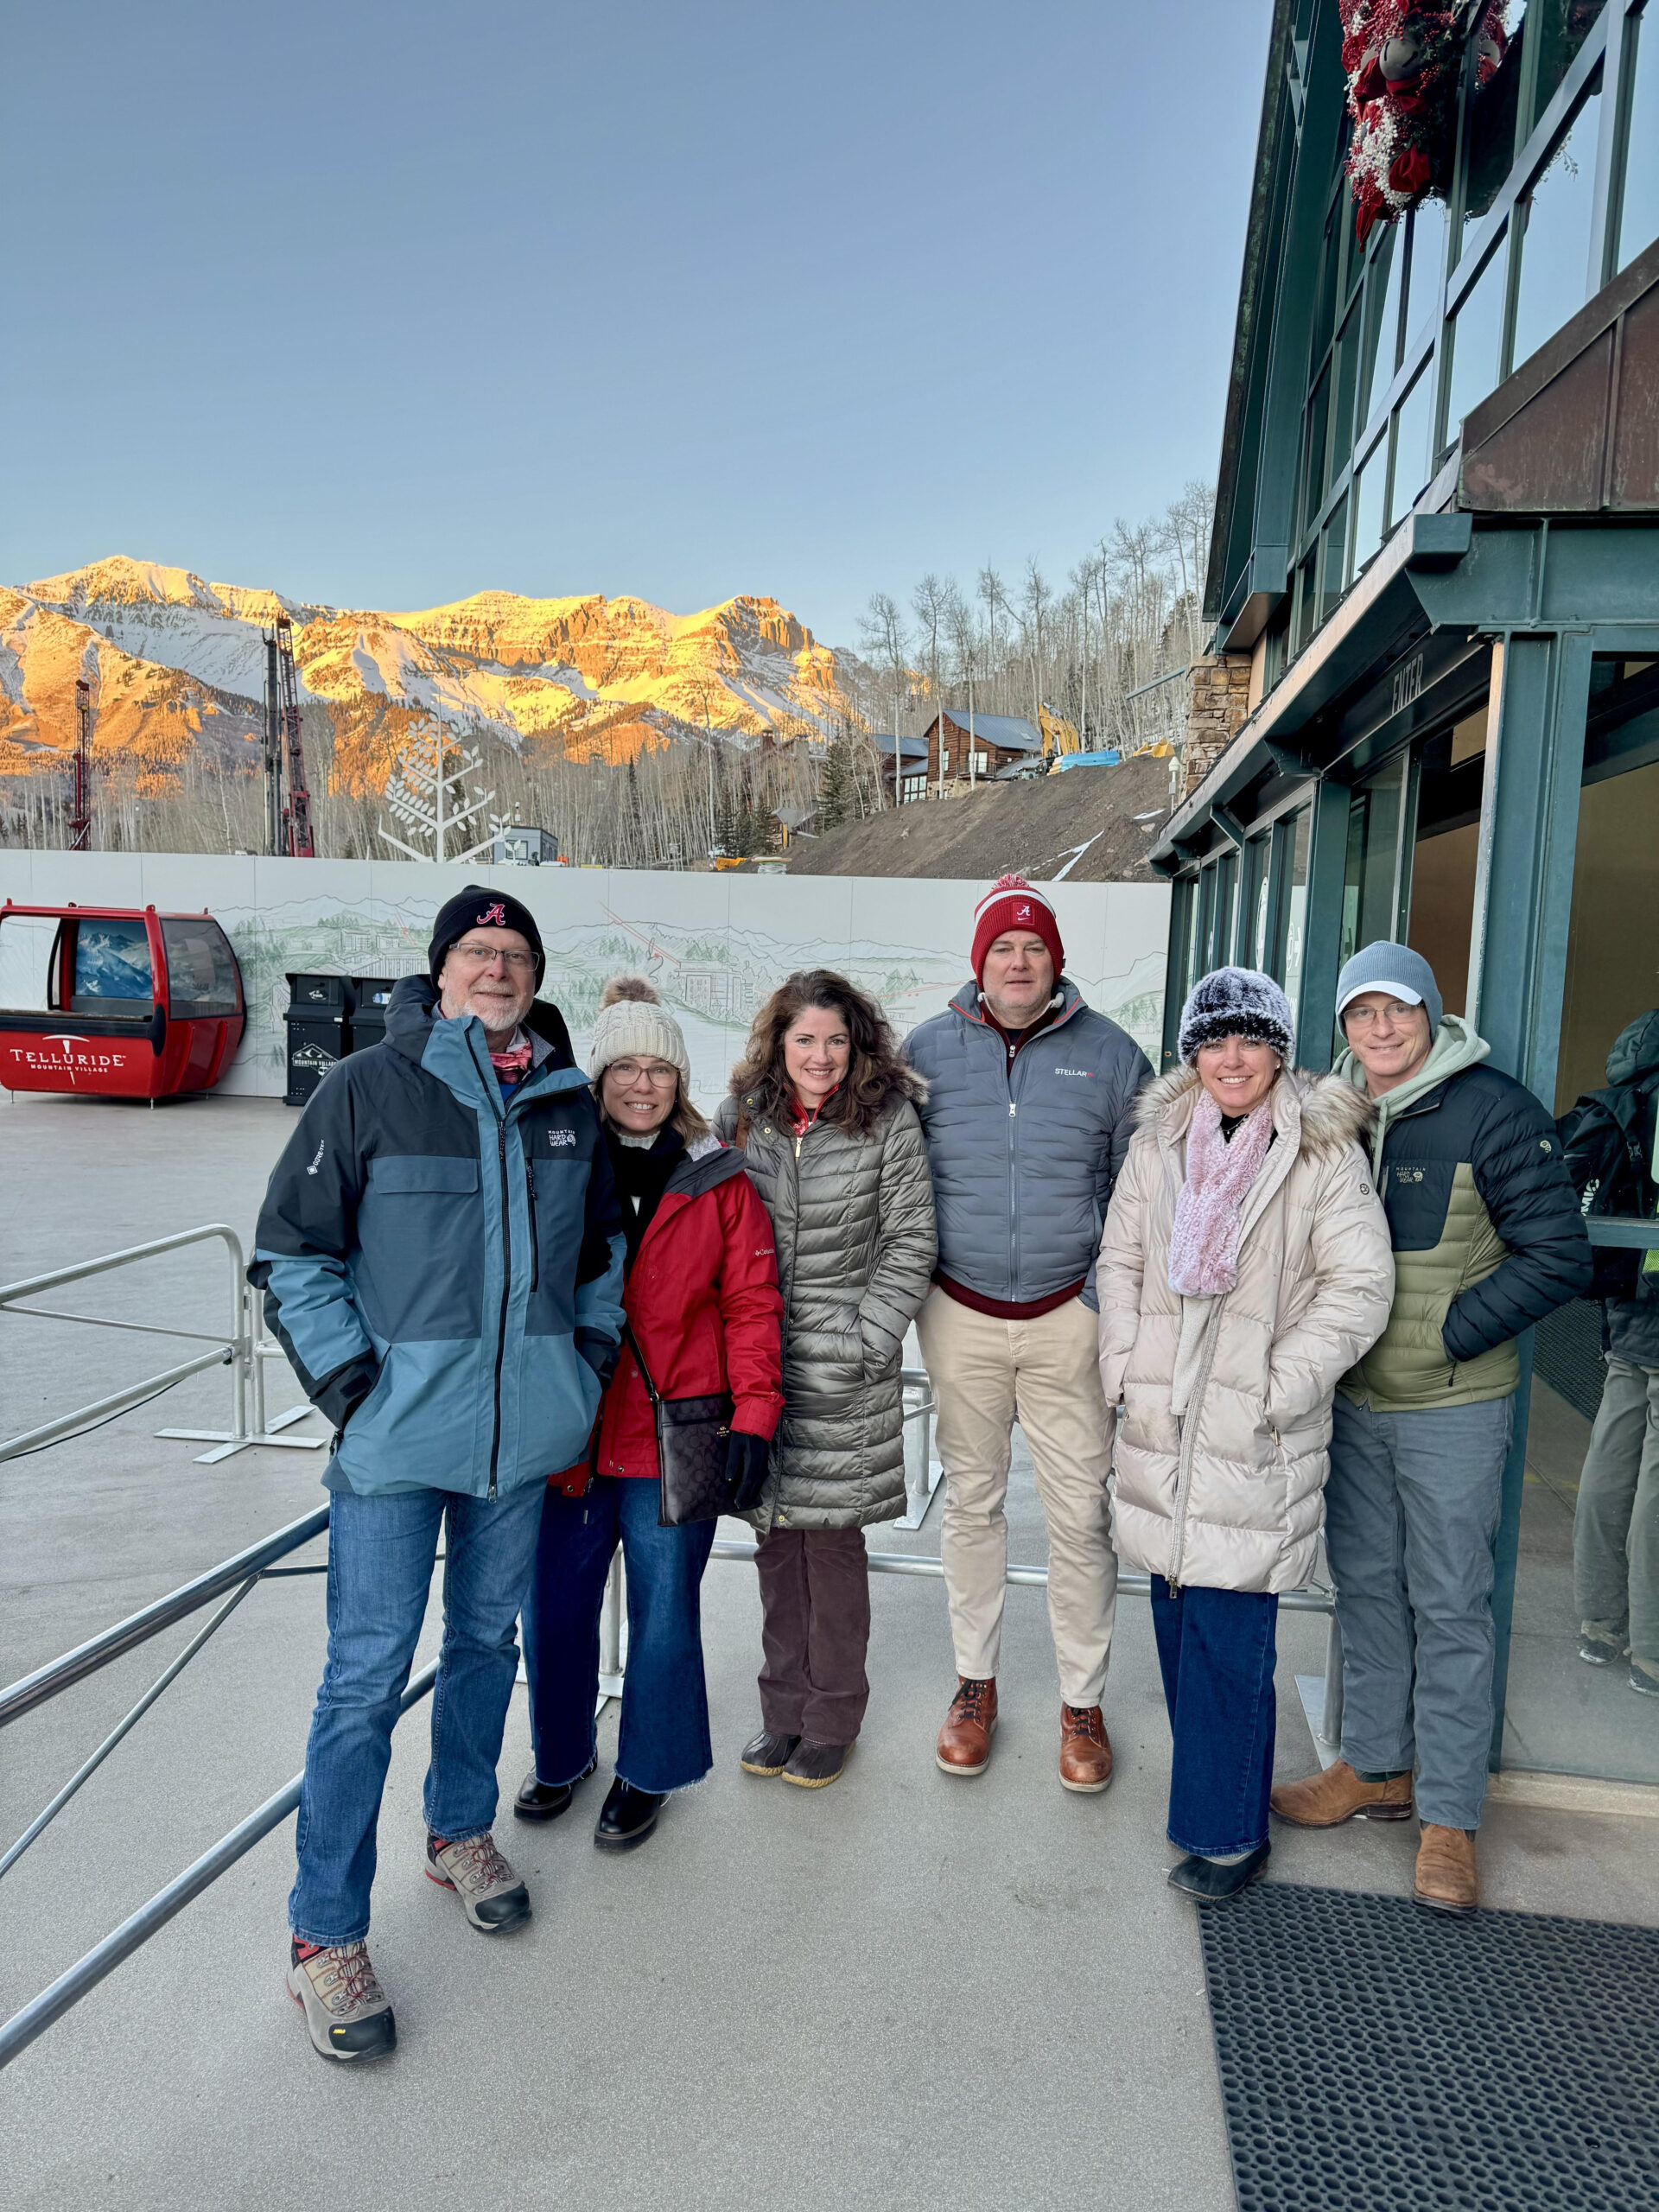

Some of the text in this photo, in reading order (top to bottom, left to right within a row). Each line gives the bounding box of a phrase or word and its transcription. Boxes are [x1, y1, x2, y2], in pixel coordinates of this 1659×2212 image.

[1392, 653, 1424, 715] ENTER
[476, 903, 506, 925] A
[1016, 905, 1031, 917] A
[10, 1048, 125, 1066] TELLURIDE
[1054, 1068, 1087, 1077] STELLAR
[1580, 1179, 1599, 1217] MIC
